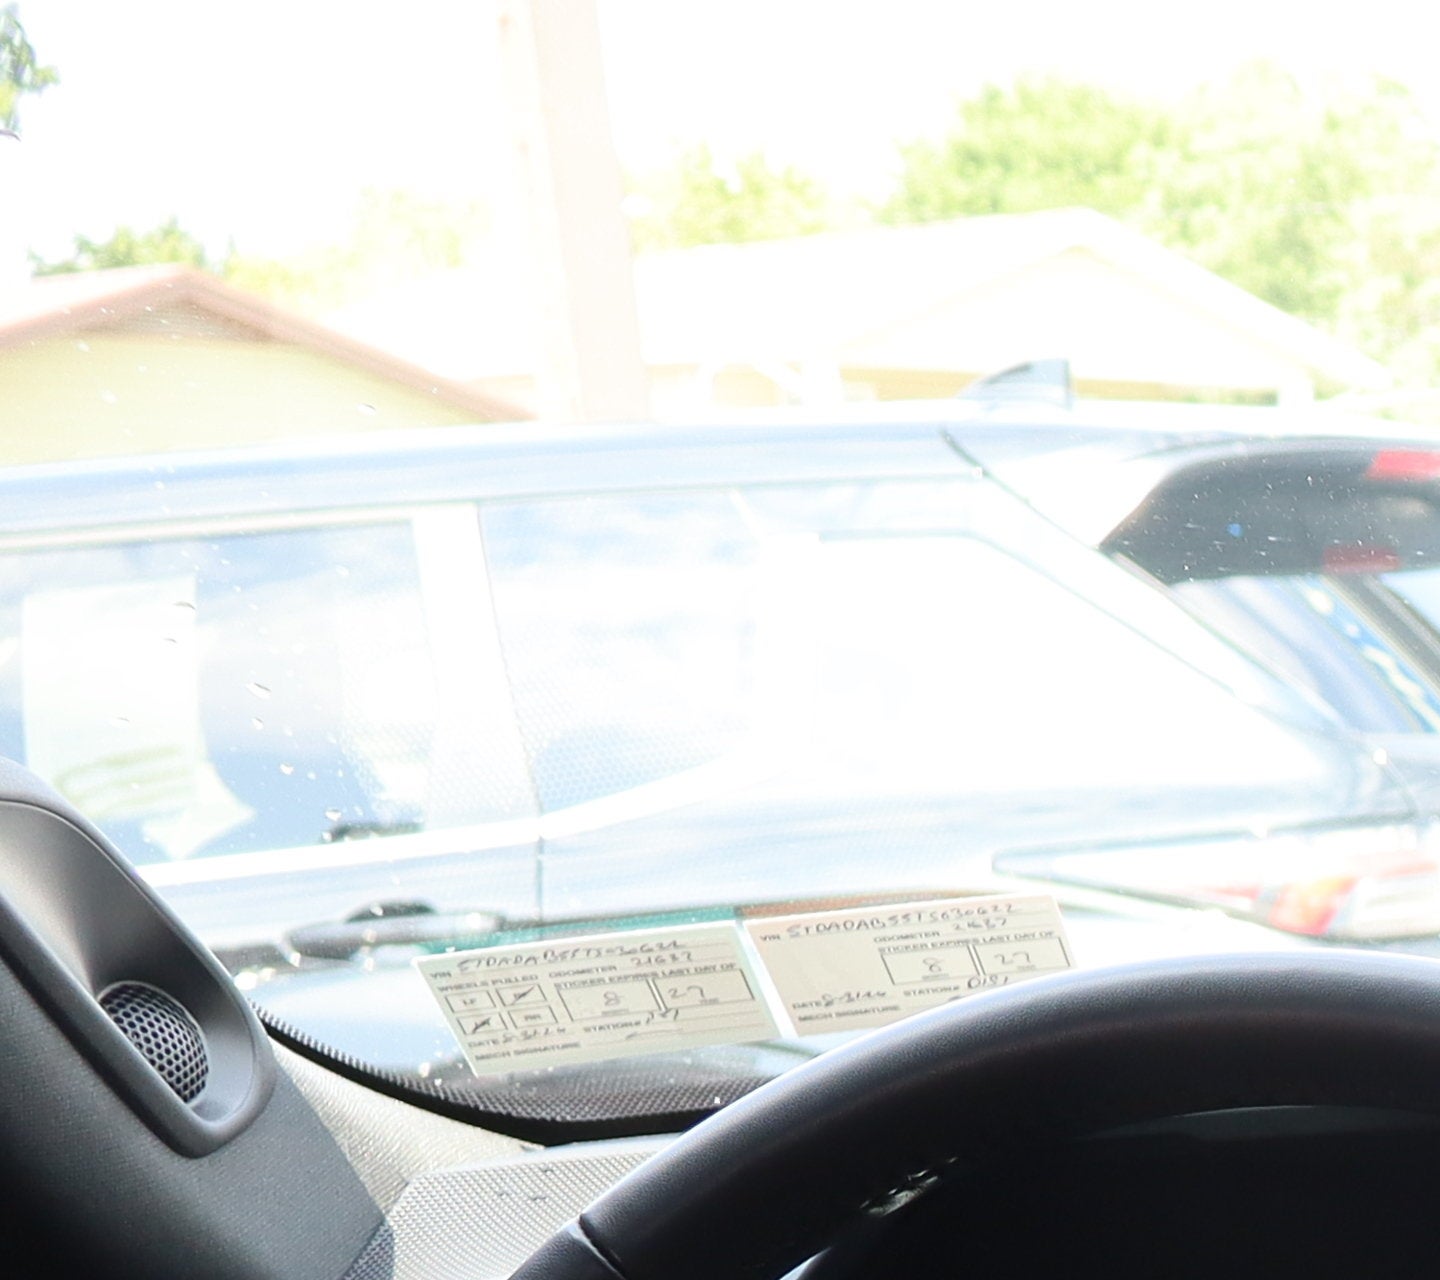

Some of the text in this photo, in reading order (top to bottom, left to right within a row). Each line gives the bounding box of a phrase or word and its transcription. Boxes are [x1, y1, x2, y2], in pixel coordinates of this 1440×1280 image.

[873, 931, 940, 943] ODOMETER
[922, 957, 944, 972] 8
[994, 951, 1031, 966] 27
[549, 965, 617, 978] ODOMETER
[603, 990, 621, 1007] 8
[667, 984, 705, 999] 27
